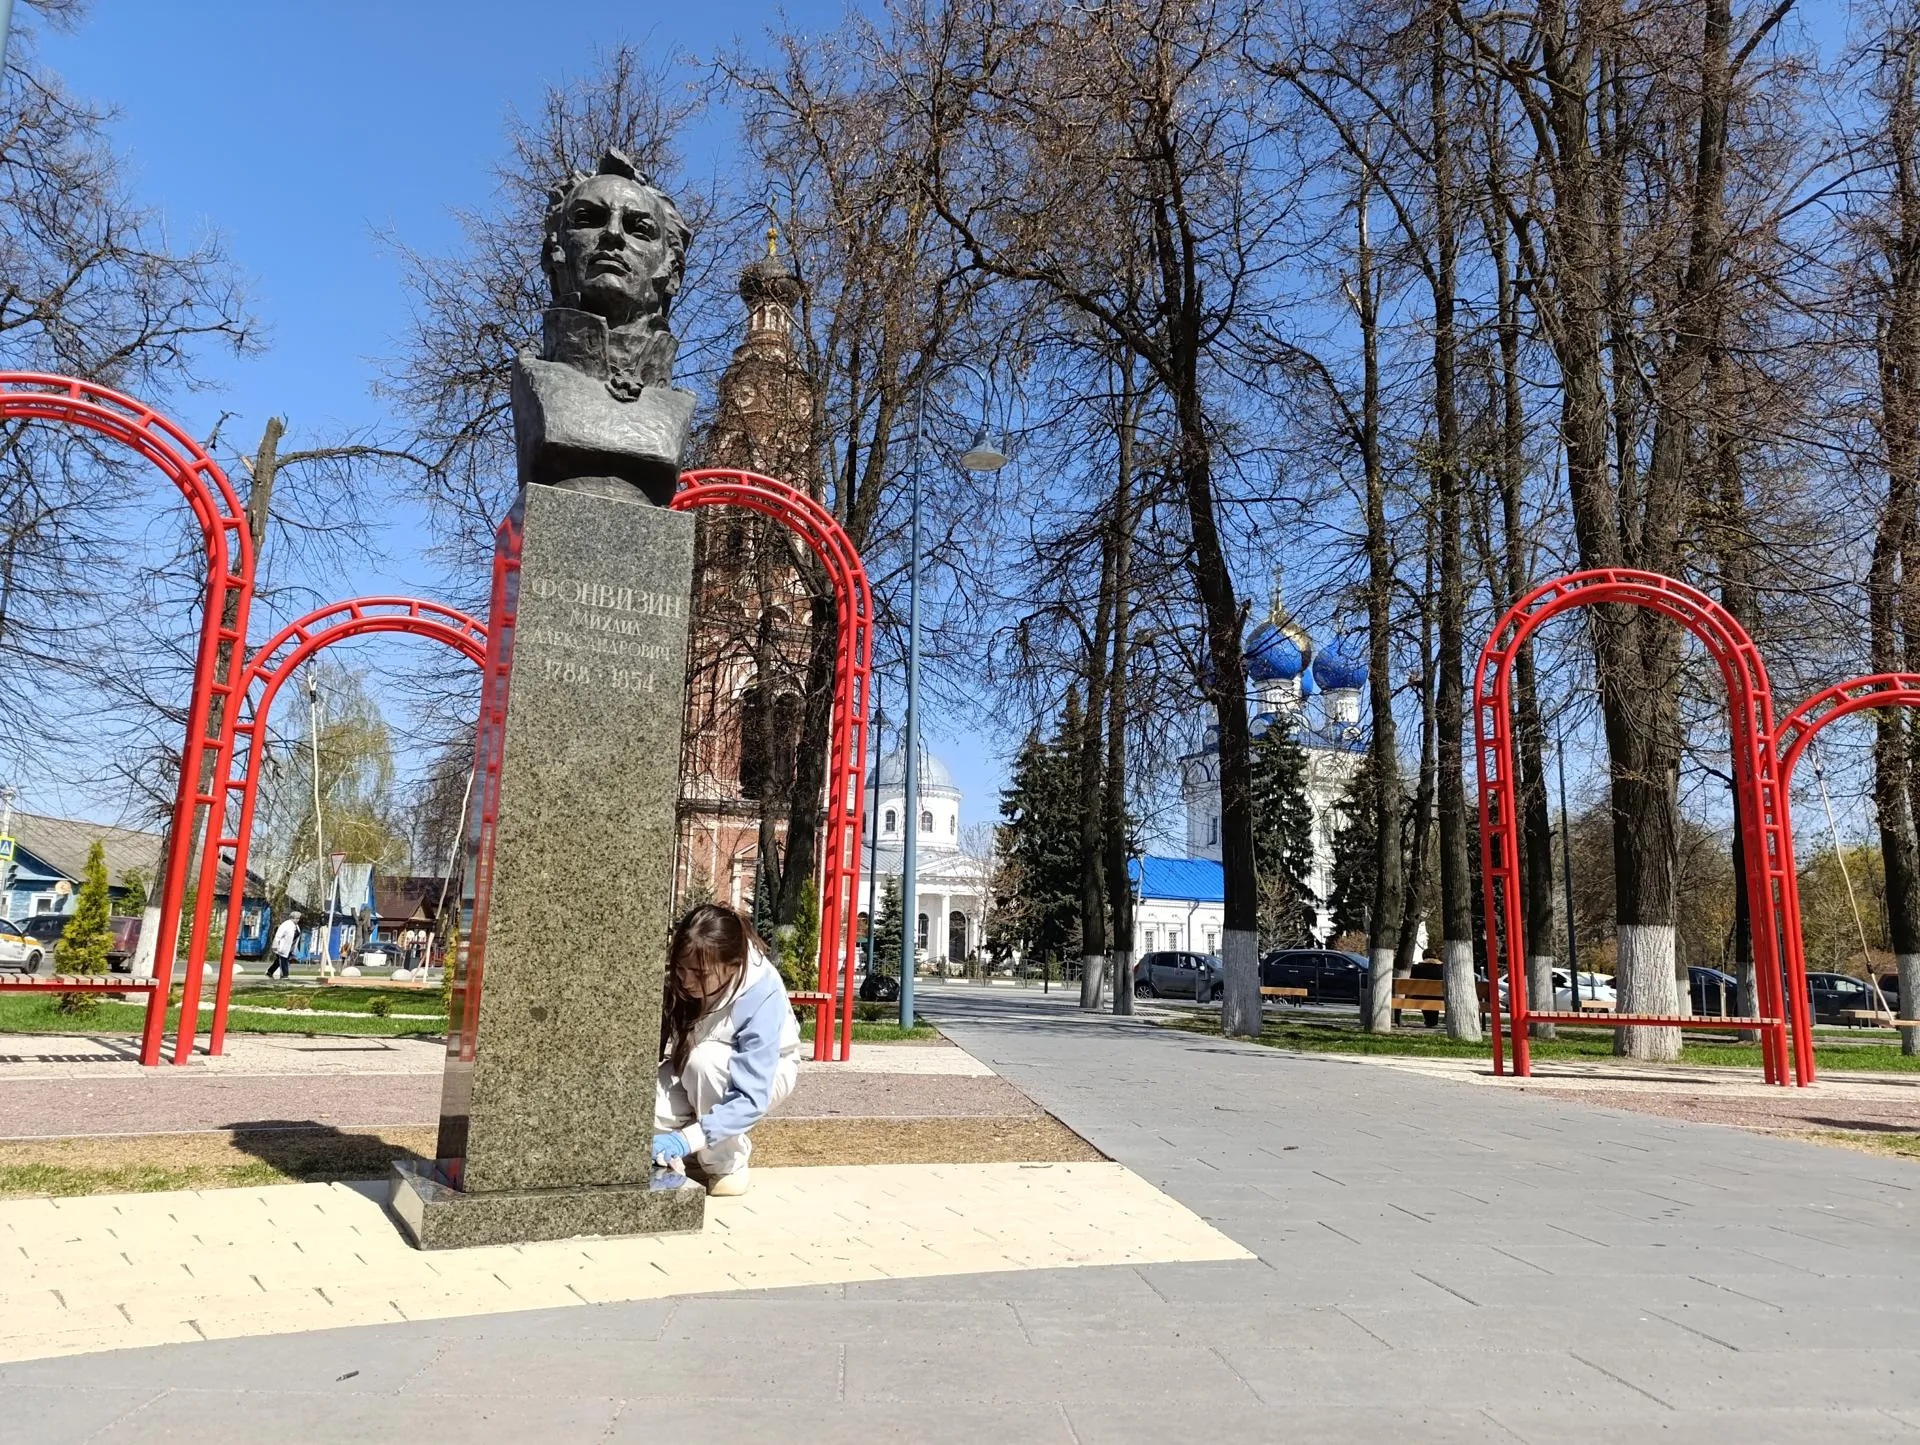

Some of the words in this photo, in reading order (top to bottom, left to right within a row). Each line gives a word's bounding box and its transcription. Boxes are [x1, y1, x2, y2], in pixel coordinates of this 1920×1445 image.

[532, 578, 681, 619] ФОНВИЗИН
[531, 627, 670, 661] АЛЕКСАНДРОВИЧ
[545, 659, 590, 684] 1788
